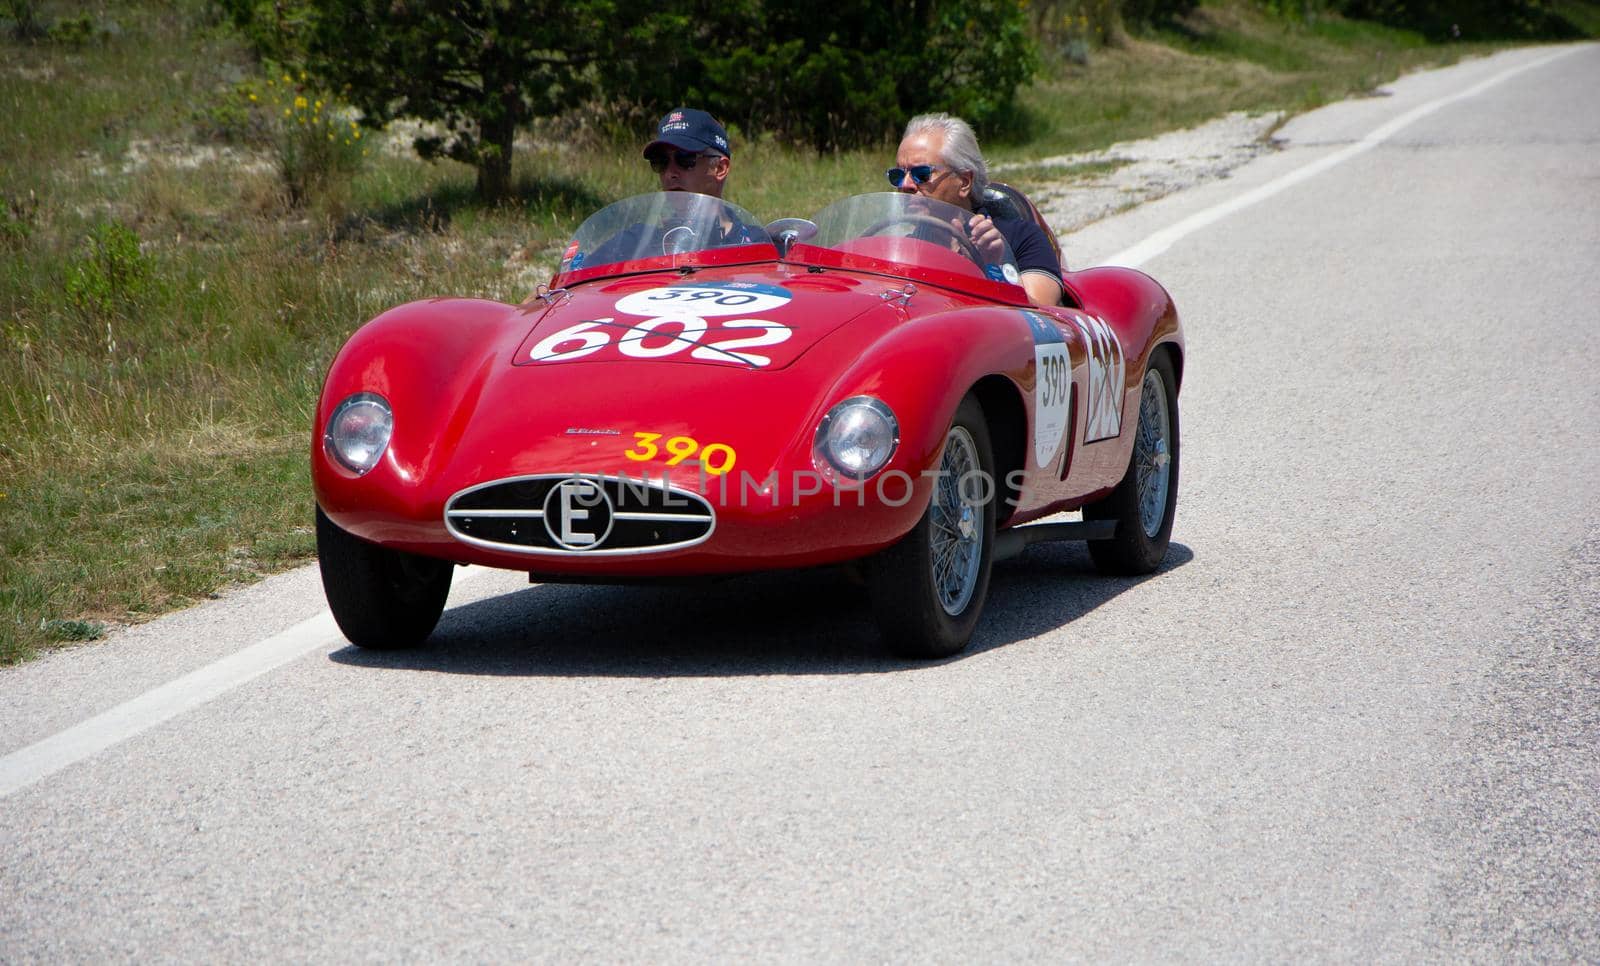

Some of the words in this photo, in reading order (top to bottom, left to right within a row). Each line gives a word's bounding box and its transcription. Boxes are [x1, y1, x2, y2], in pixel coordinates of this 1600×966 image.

[647, 288, 758, 307] 390
[529, 316, 793, 367] 602
[1042, 354, 1068, 408] 390
[624, 431, 737, 476] 390
